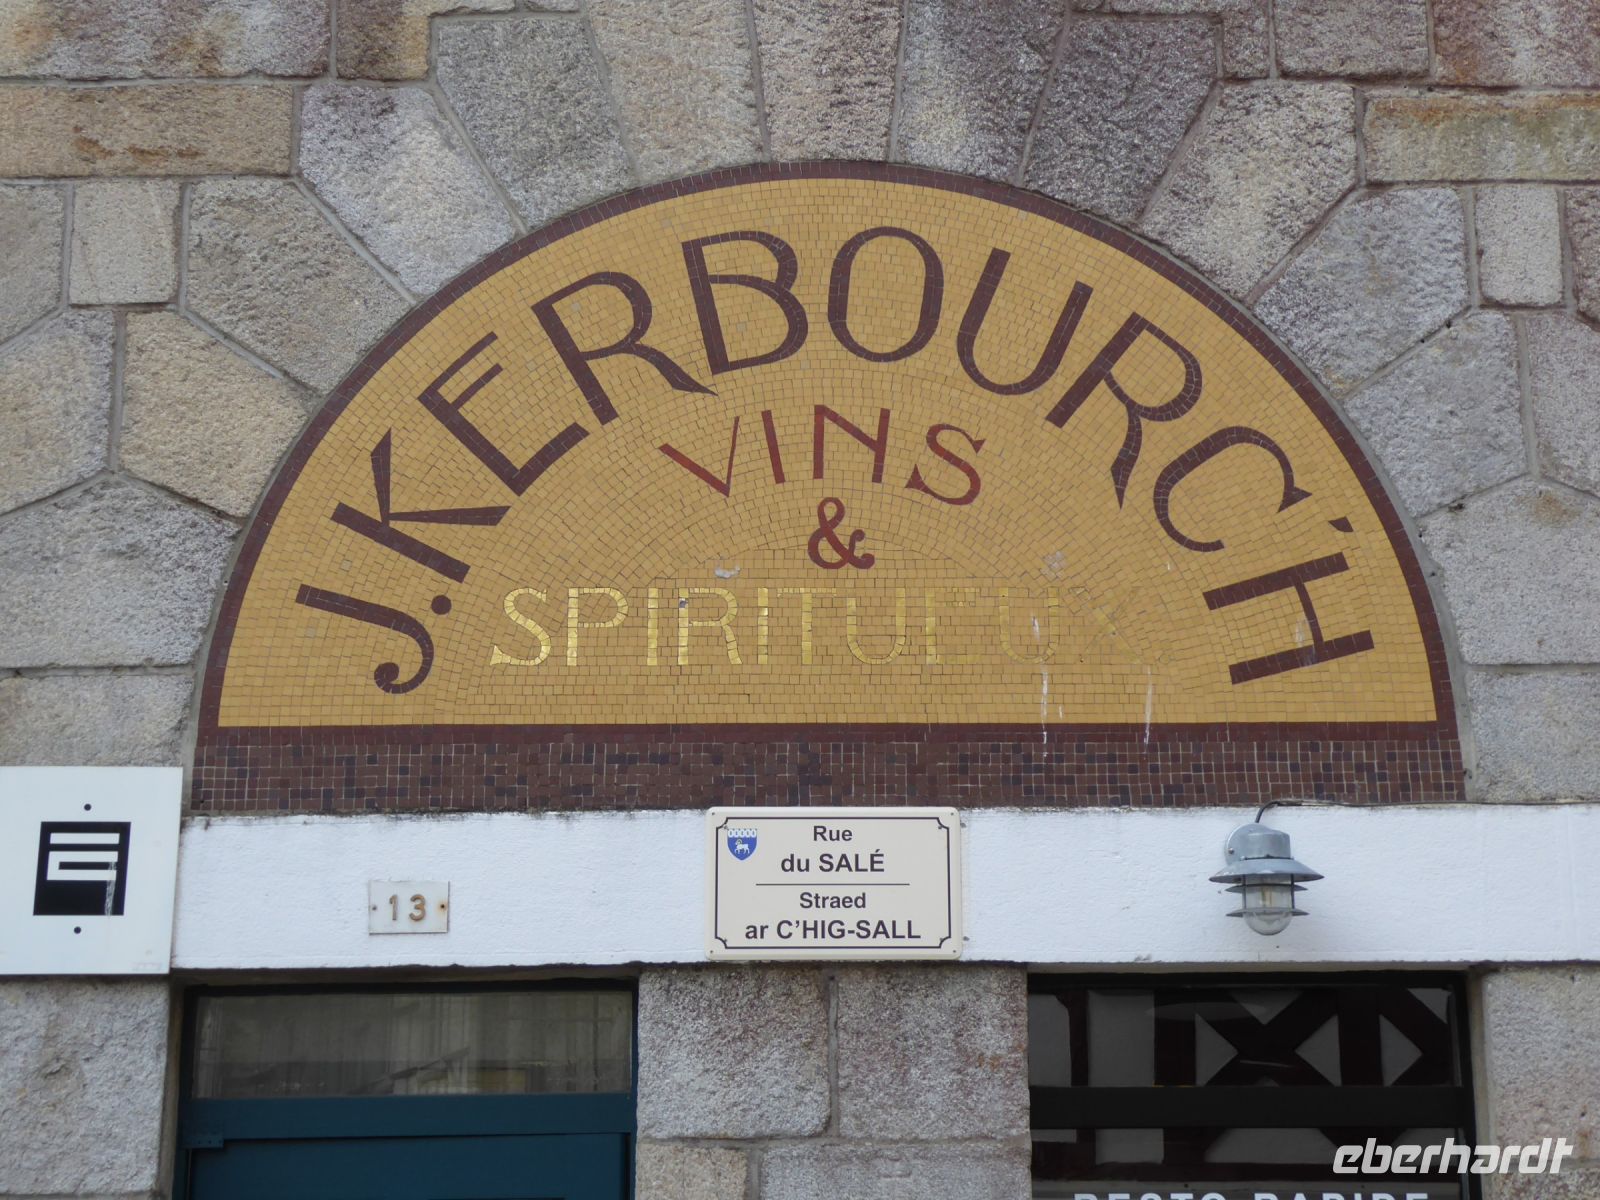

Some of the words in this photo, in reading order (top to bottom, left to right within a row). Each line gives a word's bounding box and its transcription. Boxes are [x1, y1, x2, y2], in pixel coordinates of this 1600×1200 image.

[658, 404, 986, 506] VINS
[807, 497, 875, 570] &
[813, 825, 853, 842] Rue
[781, 853, 810, 873] du
[818, 849, 885, 873] SALÉ
[388, 894, 426, 922] 13
[800, 892, 867, 909] Straed
[745, 924, 769, 940] ar
[777, 919, 921, 940] C'HIG-SALL
